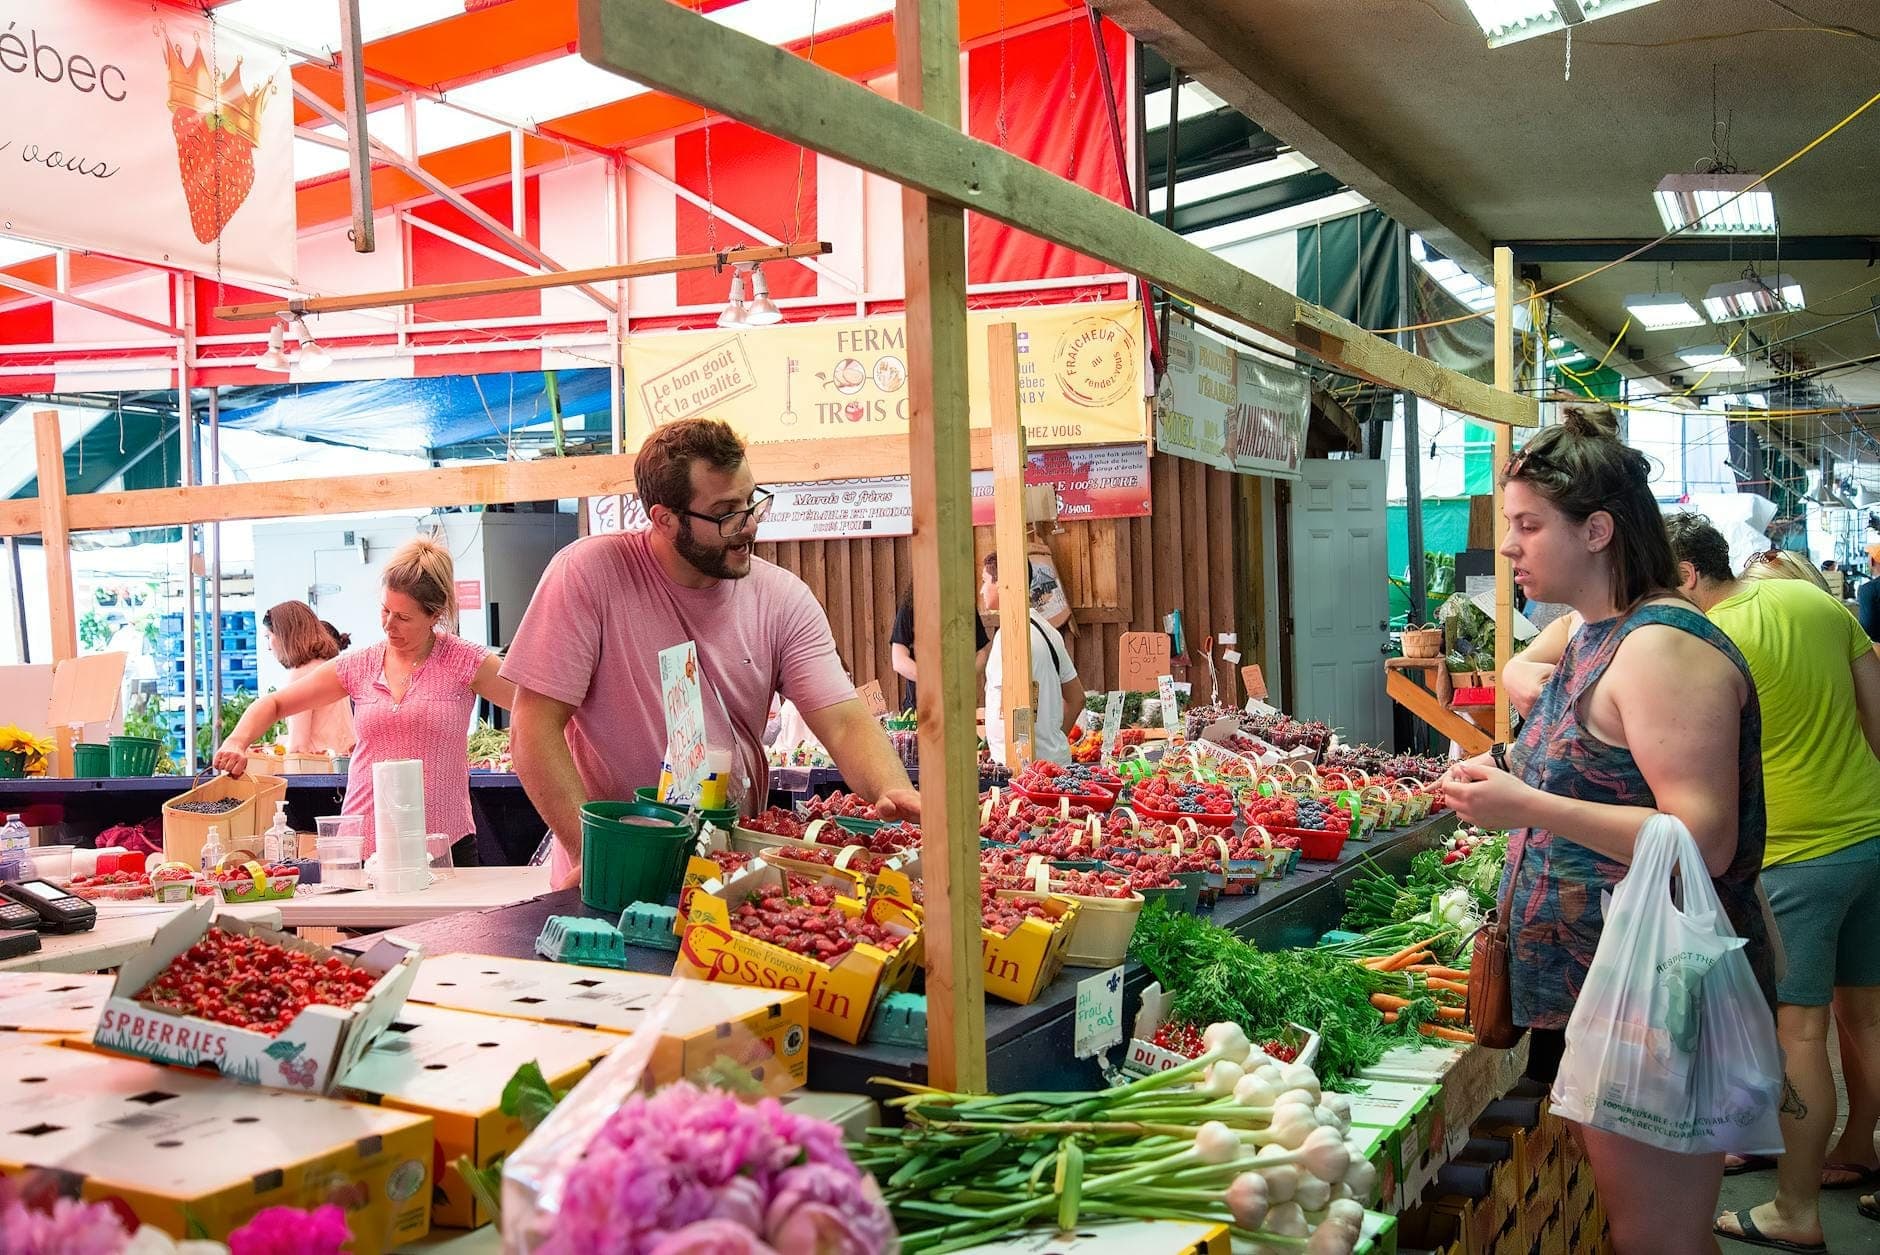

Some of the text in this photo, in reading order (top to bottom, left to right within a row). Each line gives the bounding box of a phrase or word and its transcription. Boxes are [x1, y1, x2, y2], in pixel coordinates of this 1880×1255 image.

[22, 144, 121, 178] vous
[837, 327, 905, 353] FERM
[653, 349, 735, 400] Le bon goût
[1084, 351, 1123, 389] rendez-vous
[1091, 356, 1103, 368] au
[674, 396, 690, 413] la
[692, 367, 742, 406] qualité
[1052, 425, 1082, 437] VOUS
[1069, 480, 1098, 491] 100%
[1100, 475, 1138, 488] PURE
[793, 493, 839, 506] Marois
[854, 490, 893, 506] frères
[1128, 635, 1165, 656] KALE
[733, 939, 805, 975] Ferme Français
[1695, 953, 1716, 968] THE
[682, 923, 850, 1020] Gosselin
[102, 1009, 227, 1056] SPBERRIES
[1134, 1048, 1156, 1066] DU
